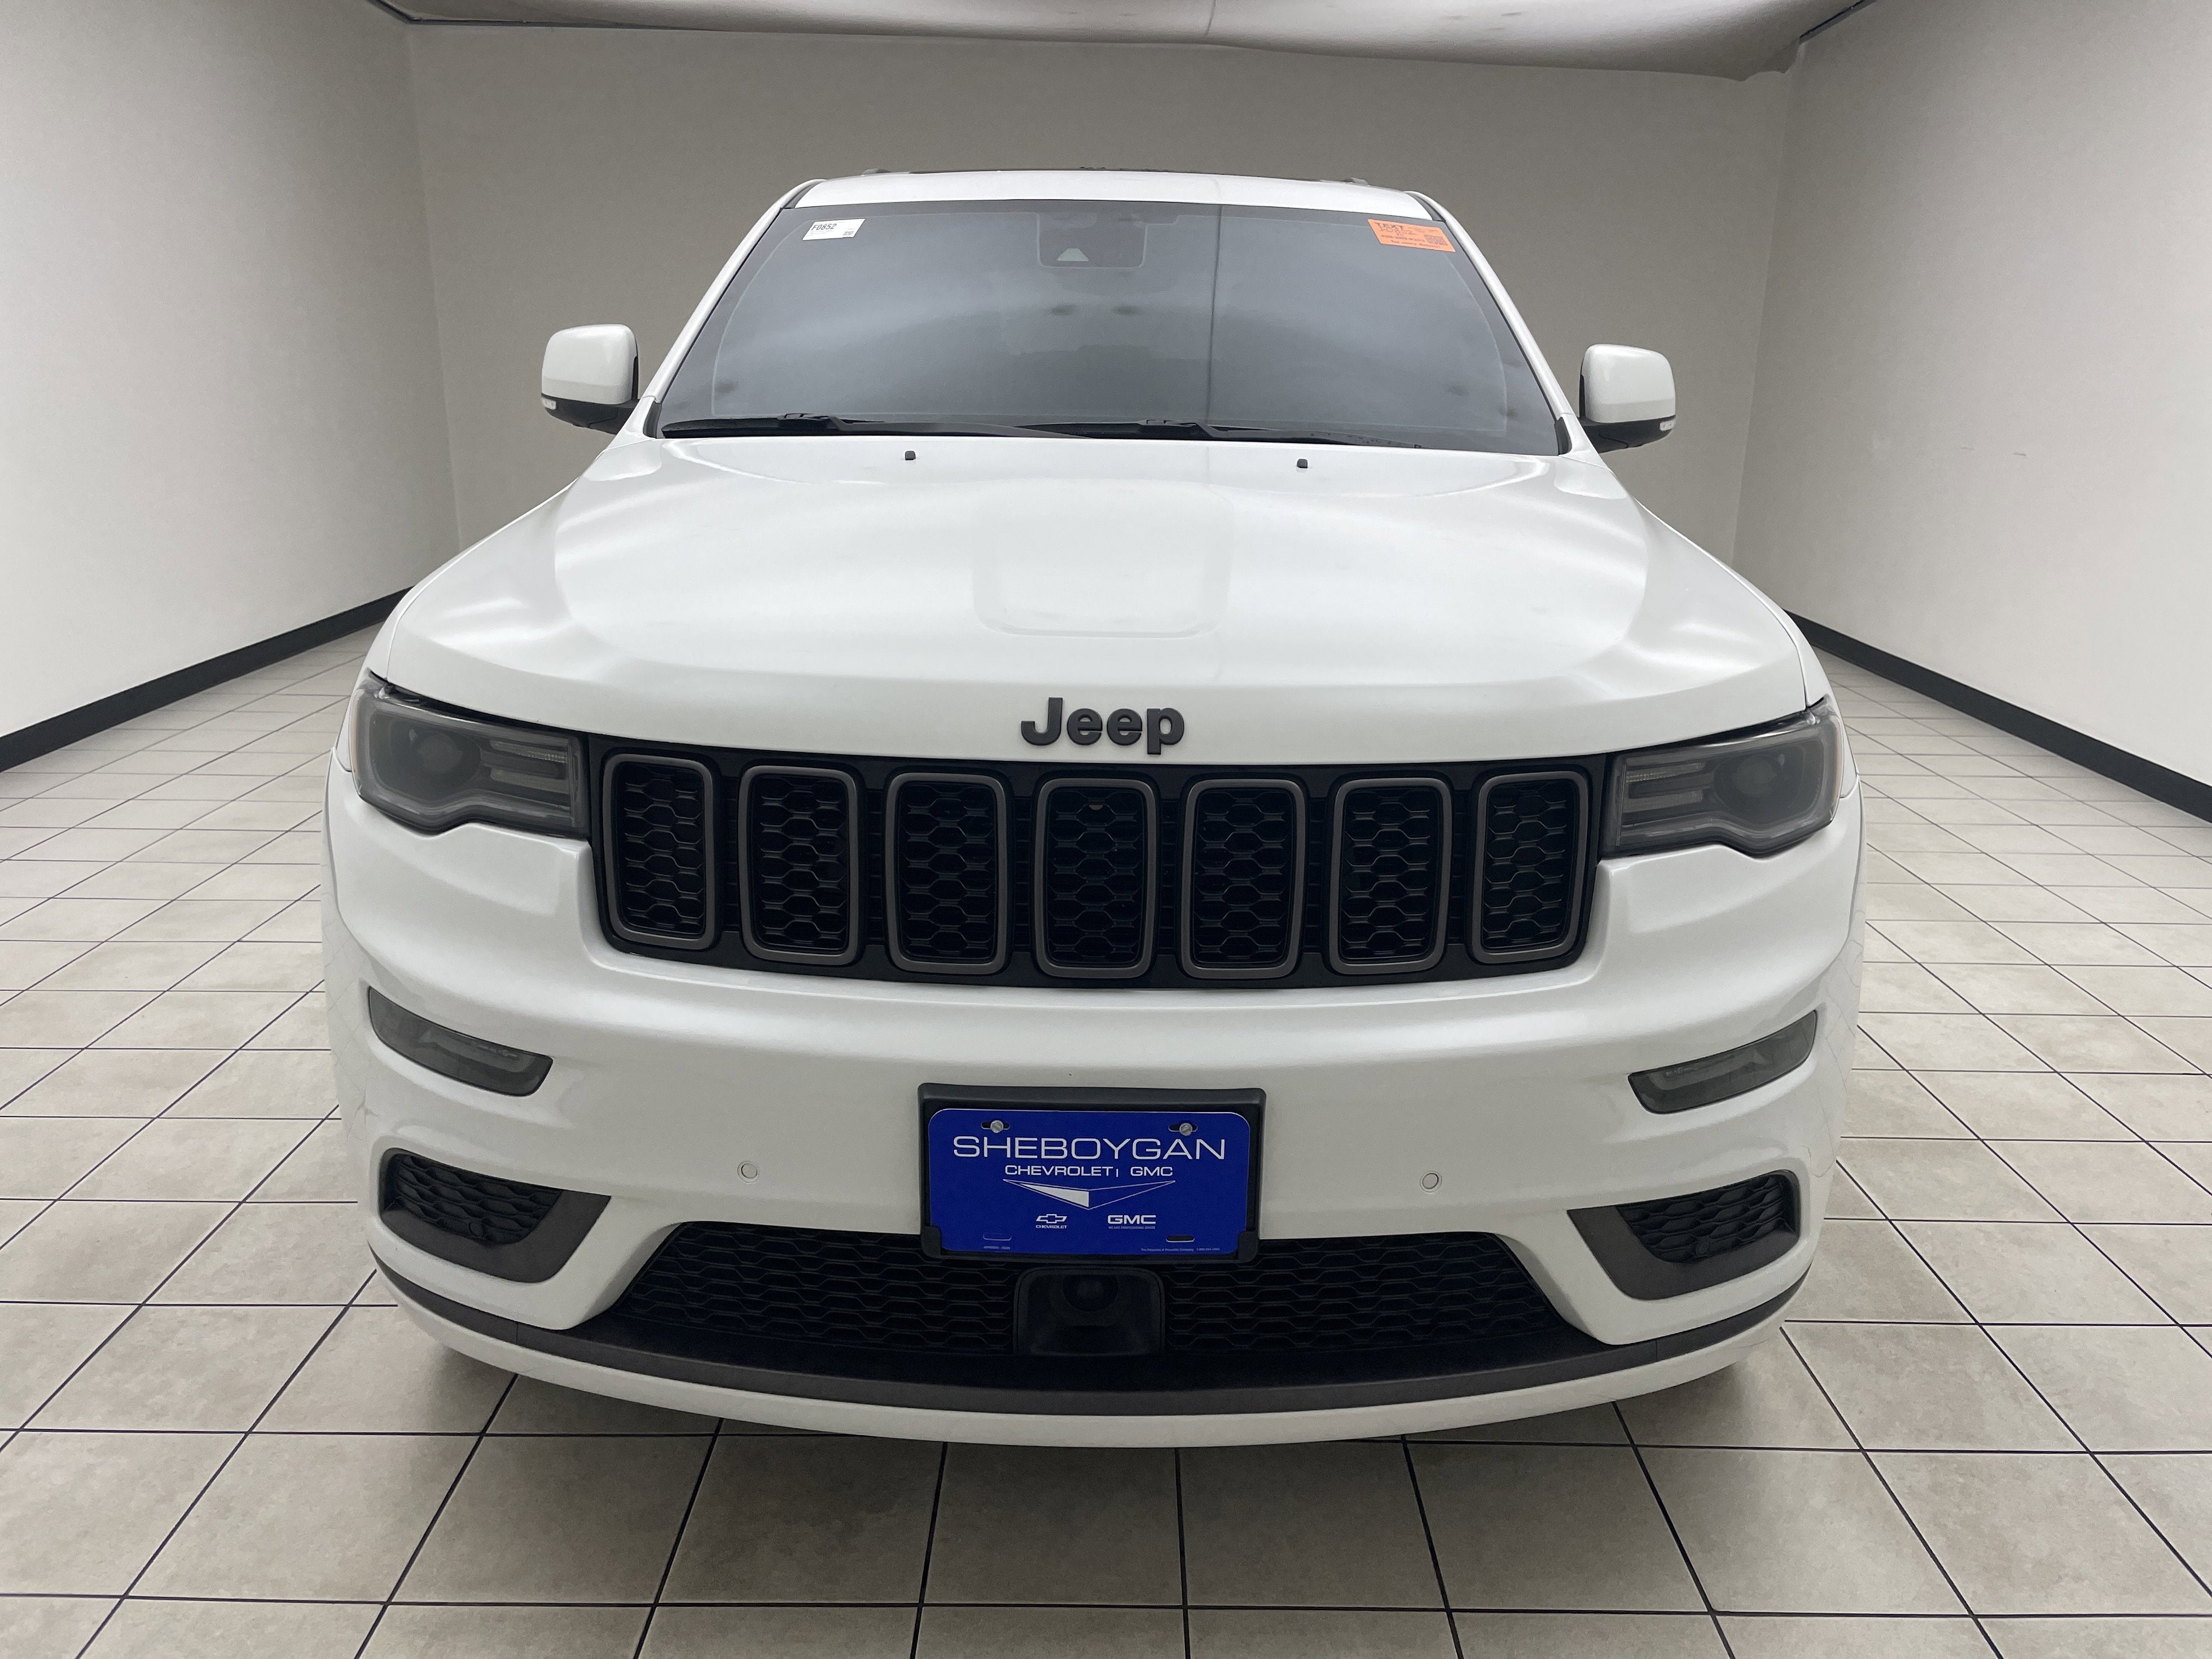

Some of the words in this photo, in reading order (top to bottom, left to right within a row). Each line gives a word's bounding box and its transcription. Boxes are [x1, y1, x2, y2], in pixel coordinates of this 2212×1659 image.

[1021, 697, 1184, 755] Jeep
[953, 1136, 1225, 1160] SHEBOYGAN
[1005, 1165, 1113, 1177] CHEVROLET
[1130, 1166, 1173, 1176] GMC
[1107, 1215, 1156, 1224] GMC
